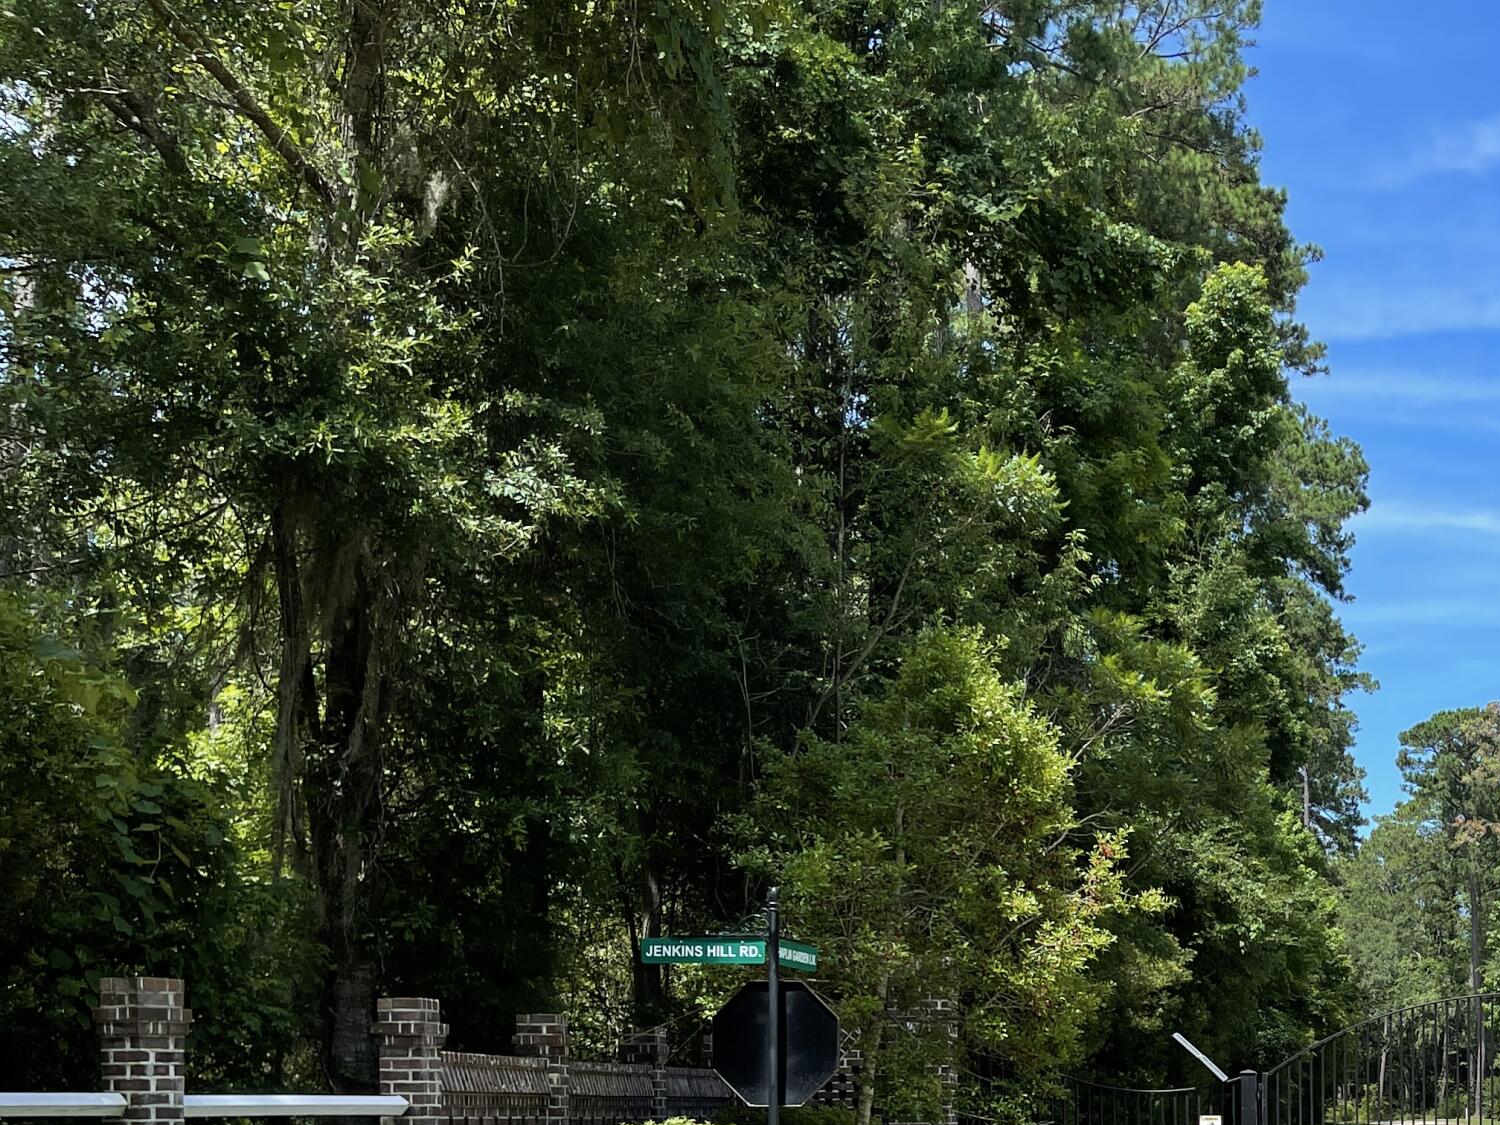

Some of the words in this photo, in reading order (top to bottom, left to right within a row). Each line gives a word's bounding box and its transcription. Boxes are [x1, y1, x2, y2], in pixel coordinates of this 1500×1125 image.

[645, 944, 703, 958] JENKINS
[706, 944, 737, 958] HILL
[739, 944, 762, 958] RD.
